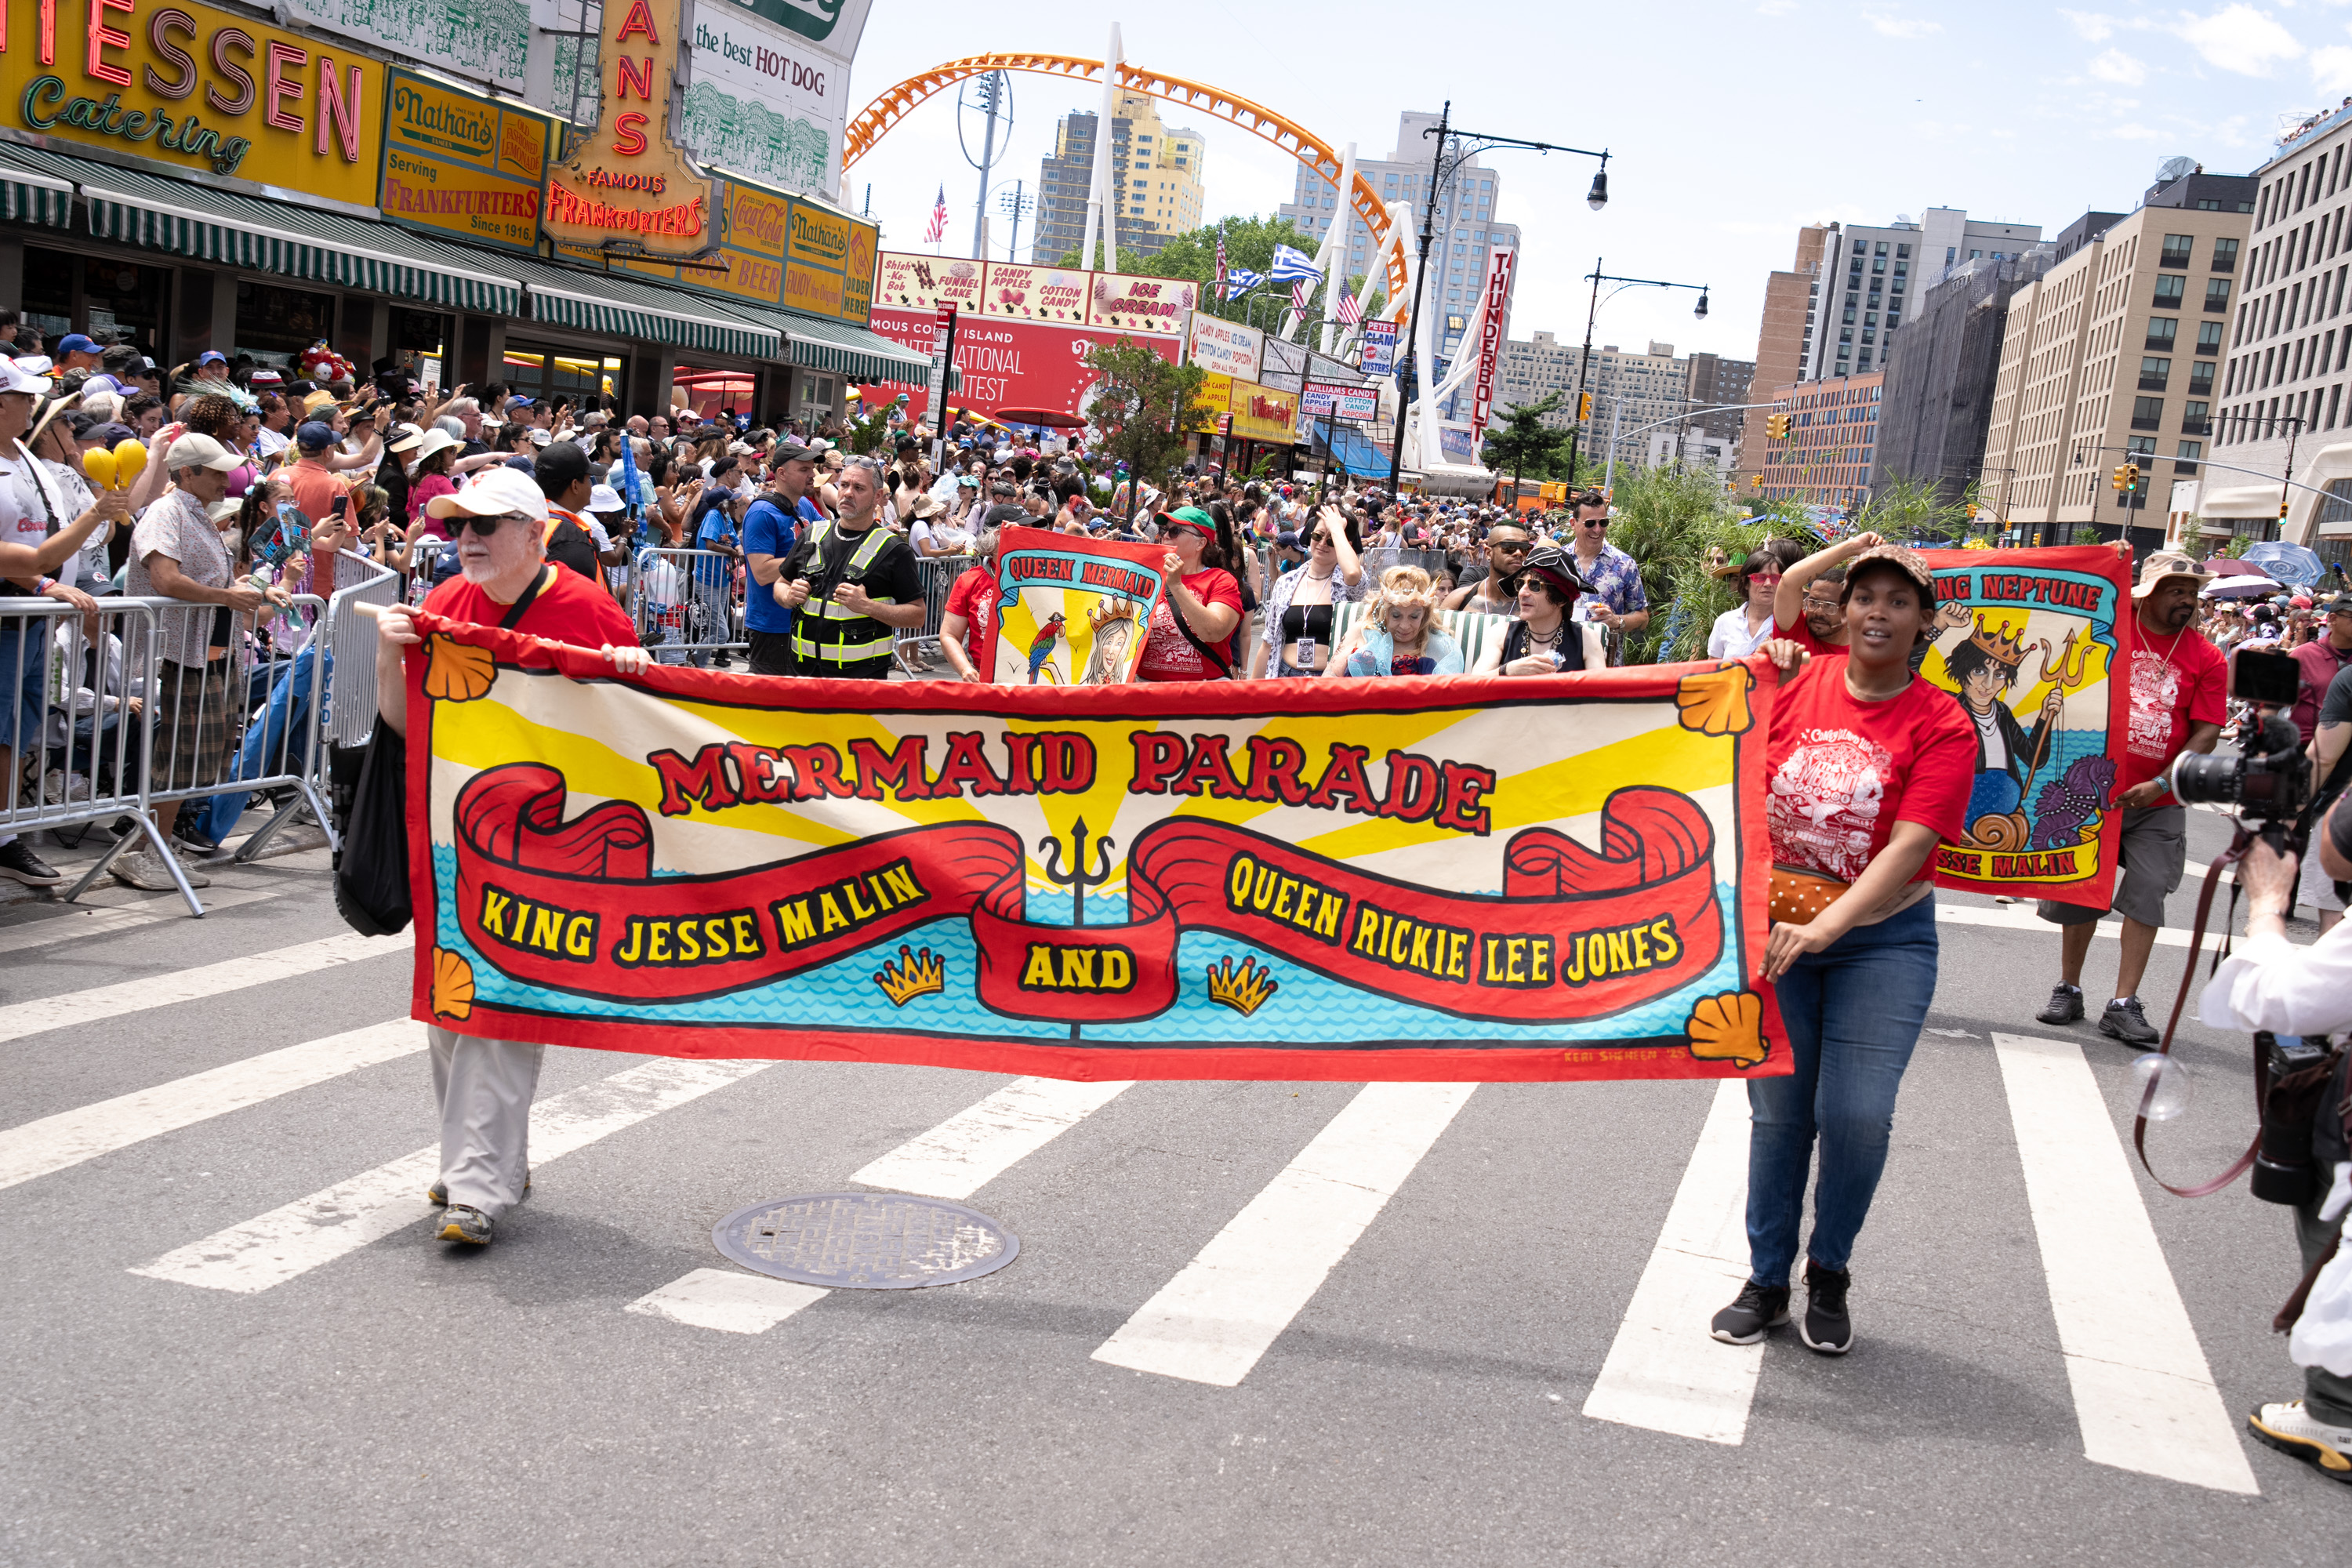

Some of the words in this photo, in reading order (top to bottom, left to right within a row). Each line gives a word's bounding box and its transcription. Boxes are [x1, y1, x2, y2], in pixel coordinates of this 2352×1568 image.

[695, 23, 719, 53] the
[723, 32, 753, 67] best
[755, 45, 789, 82] HOT
[790, 60, 825, 97] DOG
[19, 74, 252, 176] Catering
[394, 86, 495, 147] Nathan's
[517, 118, 530, 136] OLD
[506, 127, 539, 155] FASHIONED
[501, 138, 541, 171] LEMONADE
[389, 154, 437, 183] Serving
[588, 170, 666, 194] FAMOUS
[383, 177, 539, 220] FRANKFURTERS
[546, 180, 702, 236] FRANKFURTERS
[470, 215, 501, 234] Since
[504, 223, 532, 241] 1916.
[791, 212, 847, 252] Nathan's
[884, 260, 911, 271] Shish
[993, 267, 1033, 279] CANDY
[738, 259, 781, 295] BEER
[786, 269, 812, 297] ENJOY
[846, 276, 869, 296] ORDER
[887, 281, 906, 292] Bob
[938, 275, 979, 289] FUNNEL
[990, 277, 1033, 289] APPLES
[944, 287, 974, 299] CAKE
[1040, 285, 1082, 298] COTTON
[1128, 281, 1162, 298] ICE
[844, 296, 868, 317] HERE!
[1040, 296, 1080, 308] CANDY
[1110, 298, 1176, 318] CREAM
[870, 318, 909, 332] MOUS
[964, 328, 1014, 343] ISLAND
[1200, 322, 1214, 339] CANDY
[1214, 328, 1230, 343] APPLES
[1237, 333, 1252, 348] CREAM
[1367, 321, 1396, 332] PETE'S
[1365, 332, 1394, 347] CLAM
[1474, 252, 1508, 442] THUNDERBOLT
[1198, 341, 1216, 358] COTTON
[1217, 346, 1232, 361] CANDY
[1232, 350, 1252, 365] POPCORN
[1211, 361, 1221, 370] OPEN
[1229, 365, 1238, 375] YEAR
[1362, 360, 1390, 374] OYSTERS
[1211, 381, 1230, 390] CANDY
[1308, 383, 1346, 395] WILLIAMS
[1348, 389, 1376, 398] CANDY
[1207, 394, 1227, 402] APPLES
[1304, 398, 1331, 407] APPLES
[1306, 392, 1331, 401] CANDY
[1344, 397, 1373, 405] COTTON
[1314, 406, 1337, 416] CREA
[1341, 410, 1373, 419] POPCORN
[1009, 556, 1076, 582] QUEEN
[1080, 561, 1156, 600] MERMAID
[1934, 574, 1972, 601] NG
[1980, 573, 2103, 612] NEPTUNE
[1177, 655, 1202, 664] BROOKLYN
[321, 675, 333, 724] YPD
[2138, 736, 2168, 750] BROOKLYN
[1819, 760, 1841, 772] THE
[648, 729, 1098, 816] MERMAID
[1129, 730, 1497, 837] PARADE
[1841, 815, 1870, 826] THRILLS
[1936, 849, 1982, 876] SSE
[1991, 851, 2078, 878] MALIN
[480, 887, 594, 960] KING
[619, 914, 761, 962] JESSE
[777, 862, 927, 946] MALIN
[1231, 856, 1343, 938] QUEEN
[1353, 908, 1466, 982] RICKIE
[1485, 937, 1550, 984] LEE
[1564, 918, 1679, 982] JONES
[1022, 944, 1132, 991] AND
[1564, 1051, 1593, 1062] KERI
